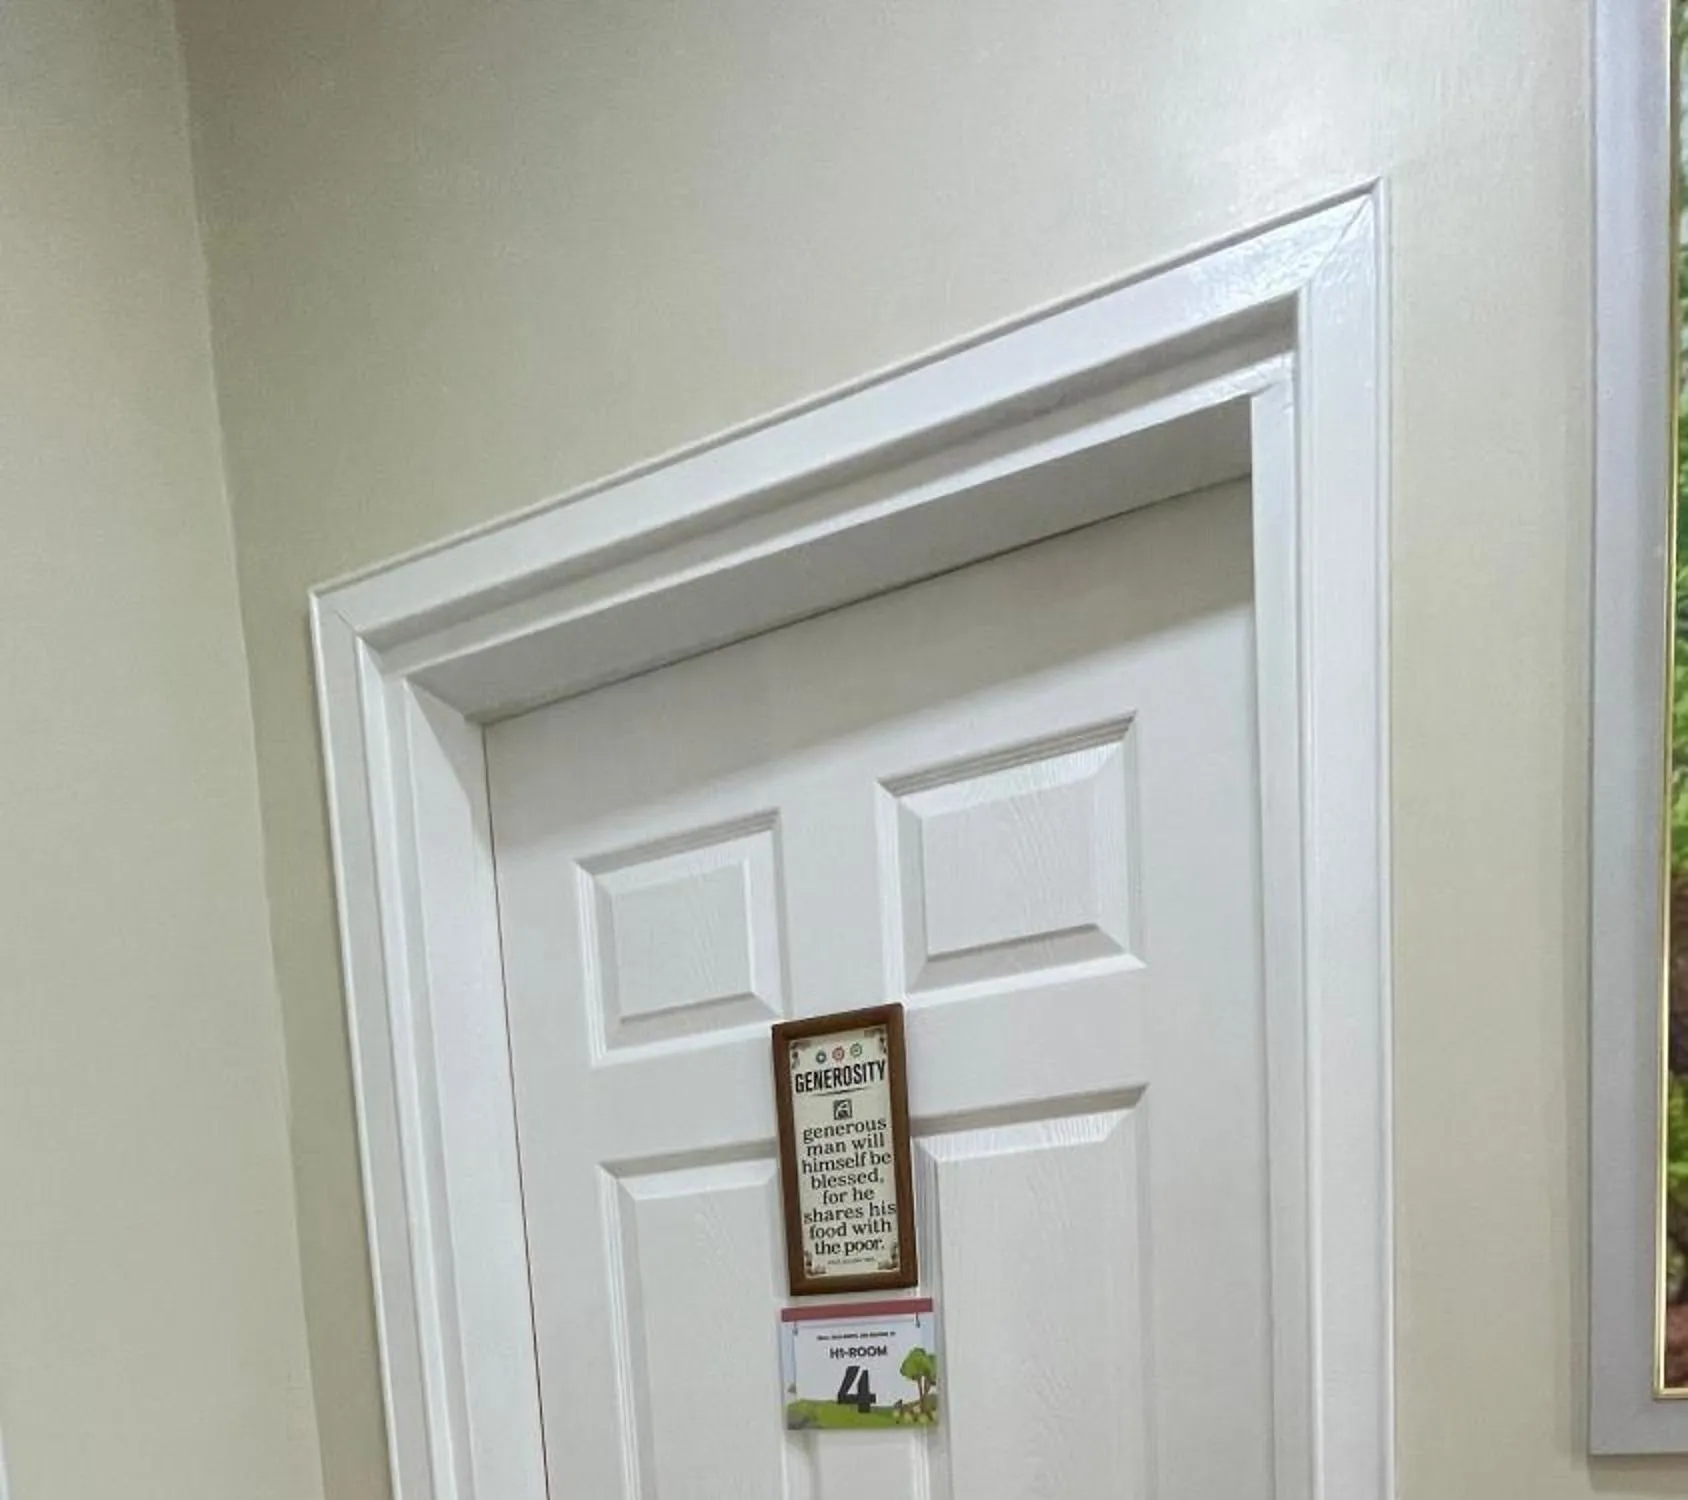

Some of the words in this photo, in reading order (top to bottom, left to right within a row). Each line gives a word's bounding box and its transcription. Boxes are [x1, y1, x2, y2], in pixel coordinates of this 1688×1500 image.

[795, 1060, 886, 1093] GENEROSITY
[803, 1118, 887, 1145] generous
[807, 1141, 846, 1157] man
[852, 1132, 885, 1150] will
[802, 1151, 867, 1174] himself
[870, 1151, 892, 1165] be
[823, 1190, 848, 1205] for
[853, 1187, 875, 1202] he
[804, 1206, 864, 1224] shares
[869, 1200, 897, 1217] his
[809, 1222, 847, 1240] food
[852, 1218, 892, 1235] with
[815, 1241, 841, 1255] the
[844, 1238, 885, 1256] poor.
[837, 1366, 877, 1413] 4
